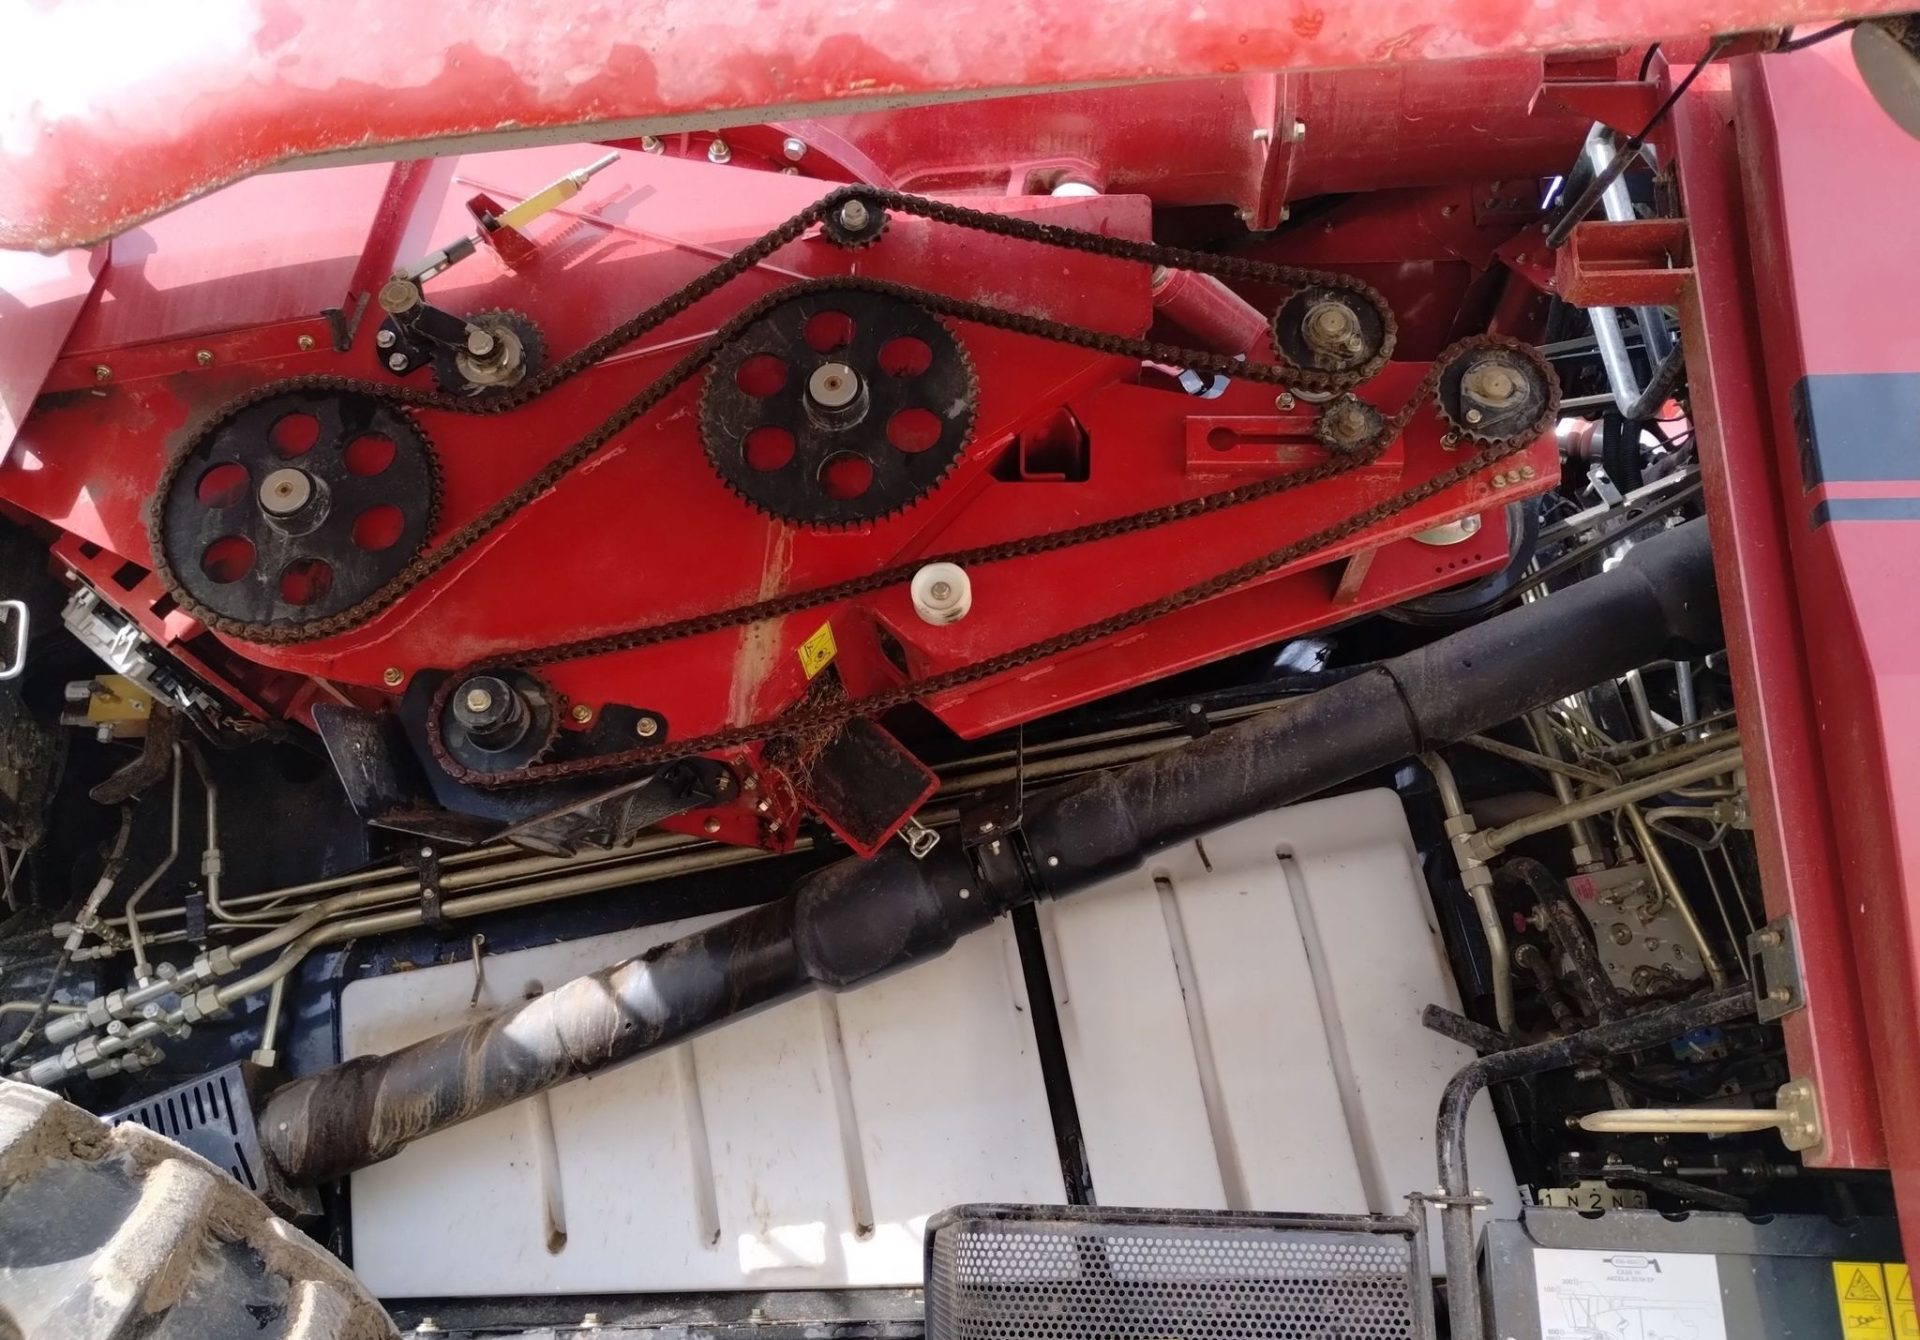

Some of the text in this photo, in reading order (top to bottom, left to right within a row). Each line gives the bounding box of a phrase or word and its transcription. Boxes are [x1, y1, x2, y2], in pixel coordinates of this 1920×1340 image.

[1567, 1195, 1579, 1207] N
[1589, 1193, 1603, 1209] 2
[1612, 1195, 1623, 1207] N
